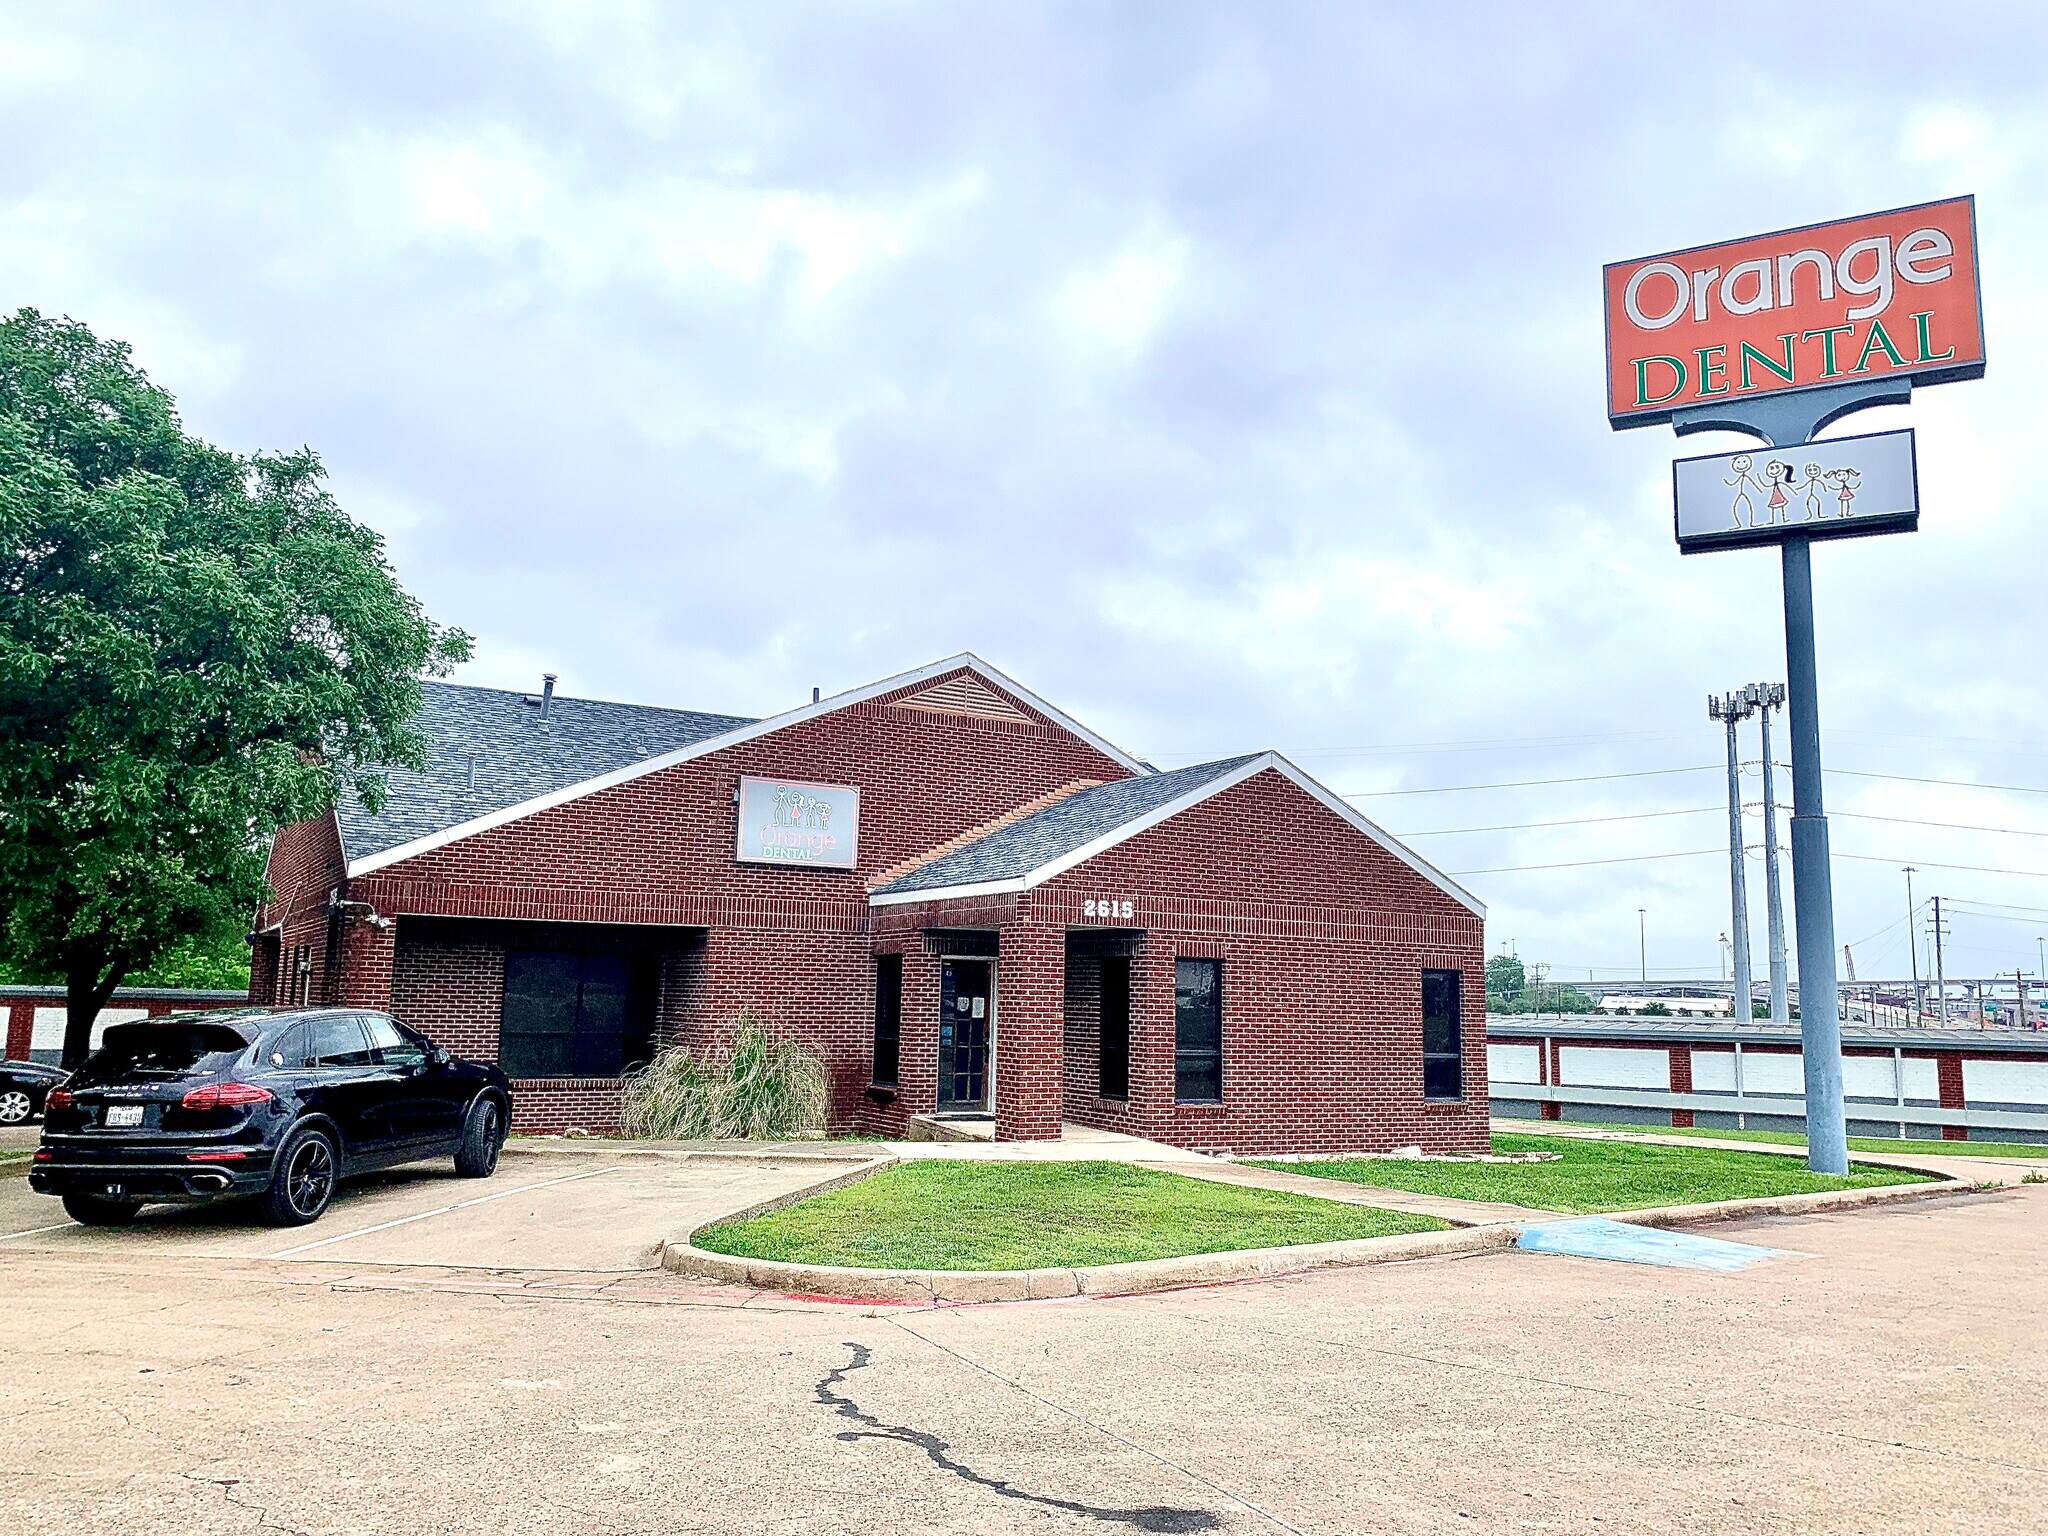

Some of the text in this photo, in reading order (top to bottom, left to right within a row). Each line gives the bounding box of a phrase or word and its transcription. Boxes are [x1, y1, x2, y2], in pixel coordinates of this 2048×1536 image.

[1624, 227, 1954, 330] Orange
[1630, 311, 1955, 408] DENTAL
[760, 824, 836, 856] Orange
[763, 846, 814, 860] DENTAL
[1083, 899, 1133, 919] 2615
